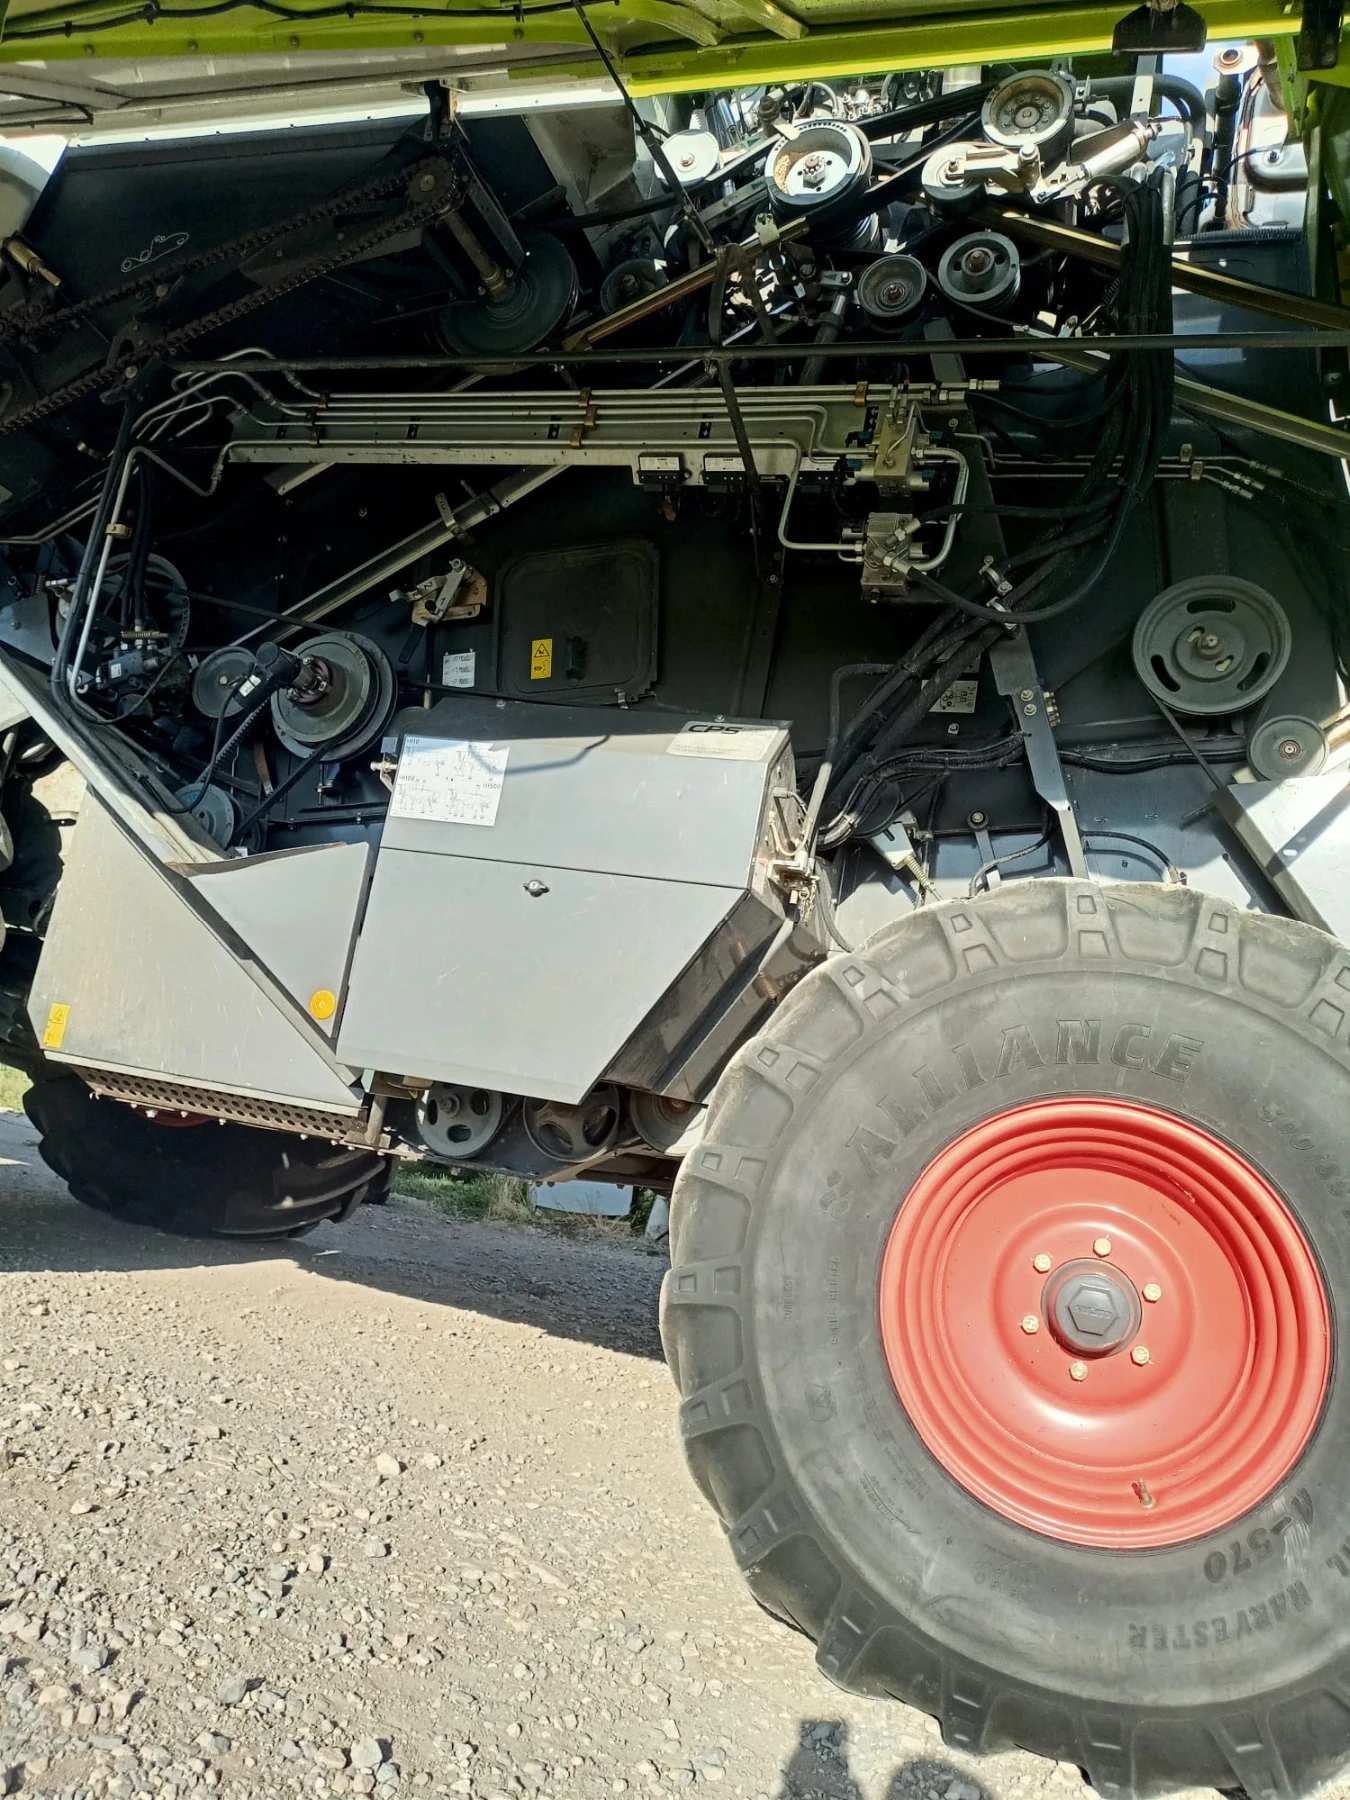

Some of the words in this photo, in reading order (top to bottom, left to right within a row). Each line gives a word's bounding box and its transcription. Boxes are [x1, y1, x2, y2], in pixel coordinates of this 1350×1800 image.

[688, 724, 743, 735] CPS
[845, 1019, 1205, 1181] ALLIANCE
[1128, 1579, 1313, 1650] HARVESTER
